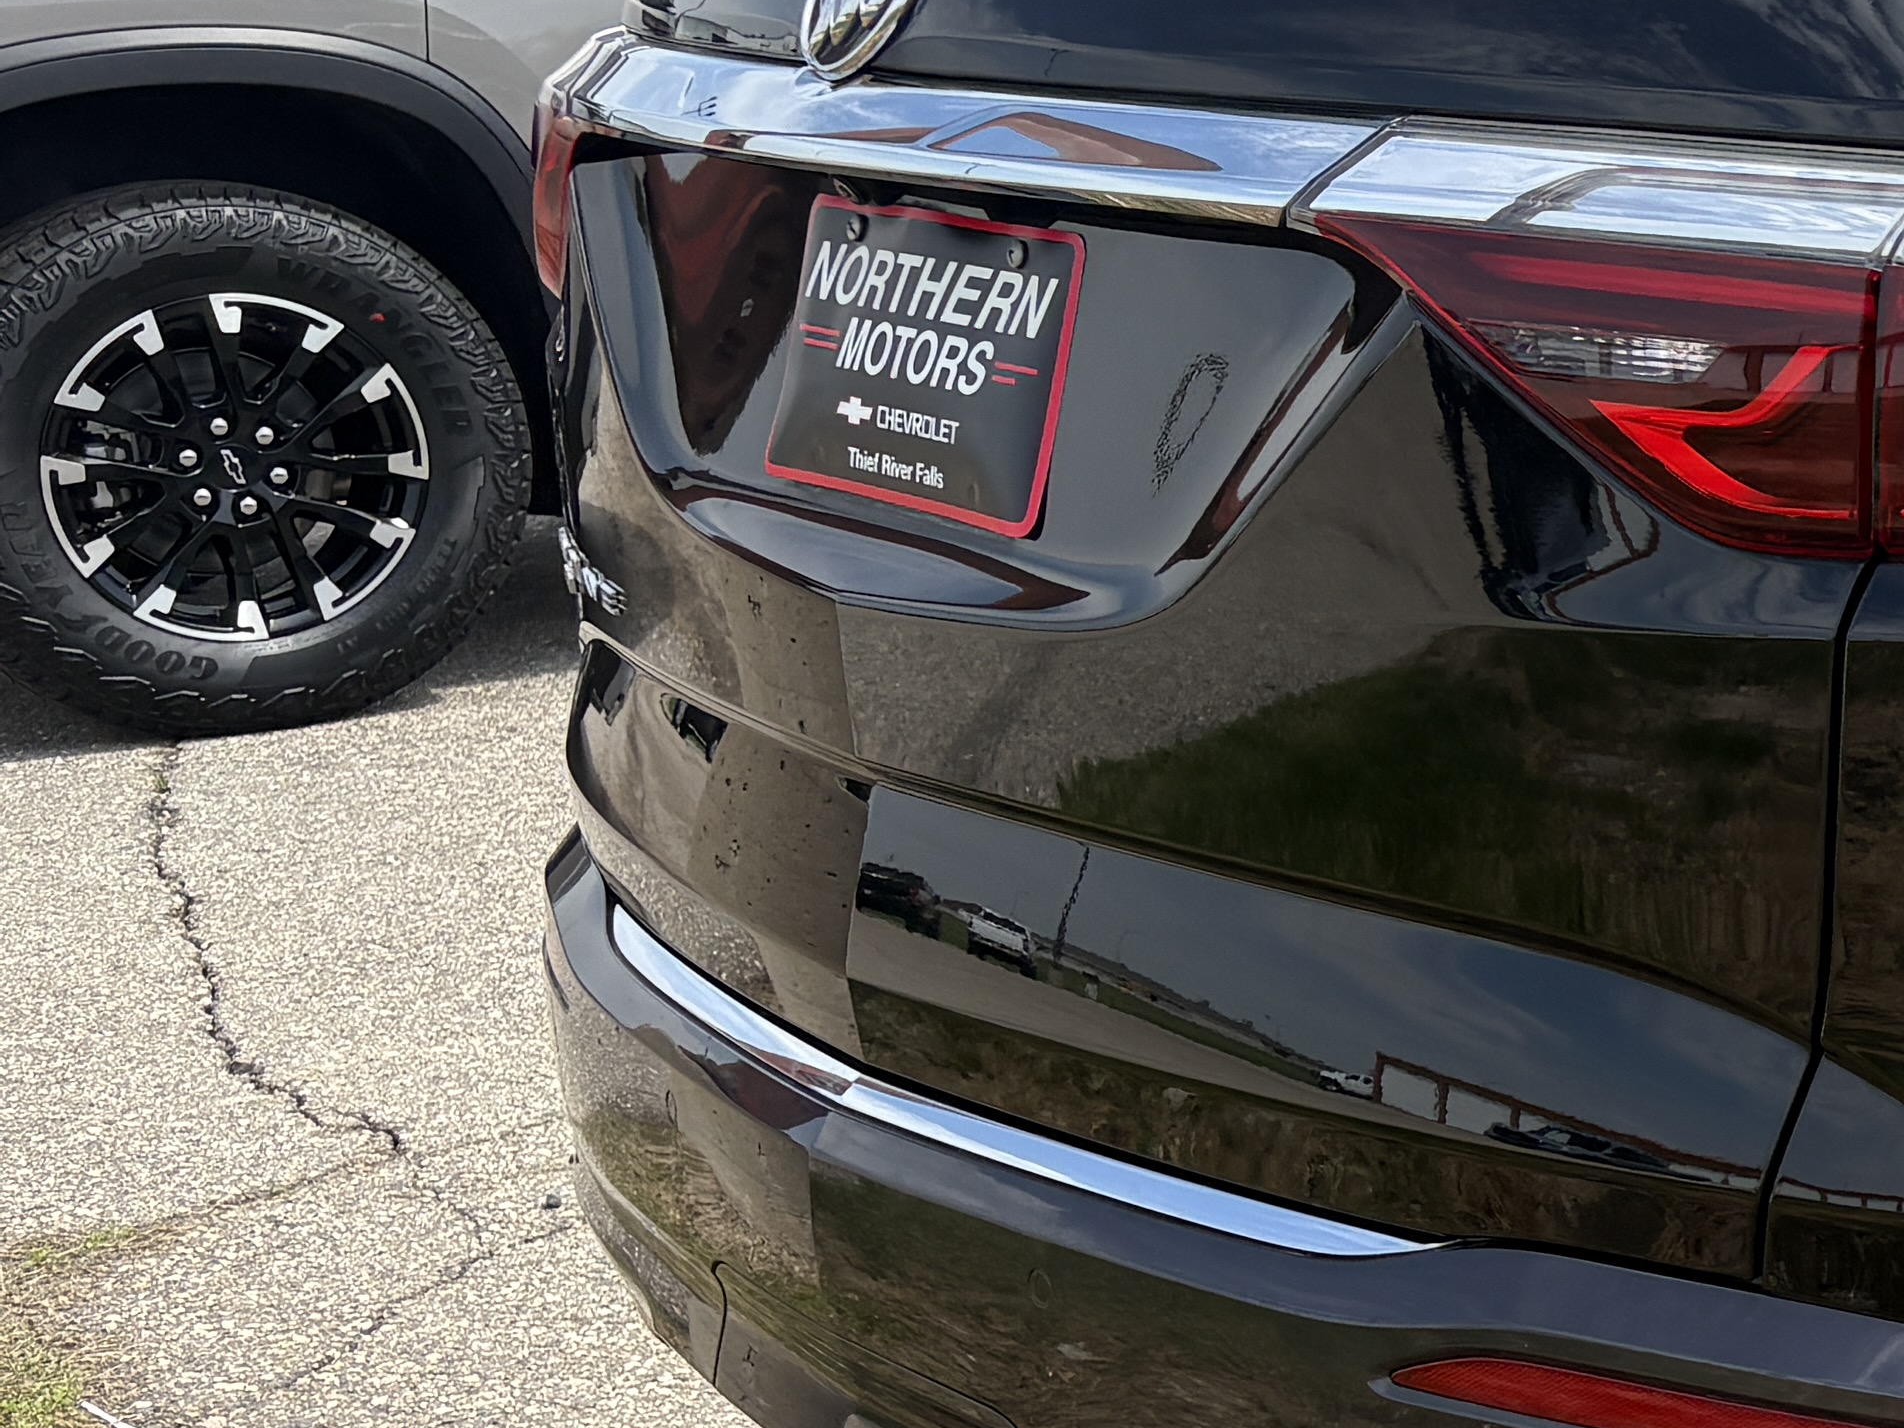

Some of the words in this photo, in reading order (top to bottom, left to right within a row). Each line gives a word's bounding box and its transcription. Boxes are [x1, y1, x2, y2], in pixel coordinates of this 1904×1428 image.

[805, 240, 1059, 339] NORTHERN
[835, 316, 995, 396] MOTORS
[876, 405, 960, 445] CHEVROLET
[847, 446, 880, 474] Thief
[881, 454, 914, 481] River
[915, 462, 944, 489] Falls
